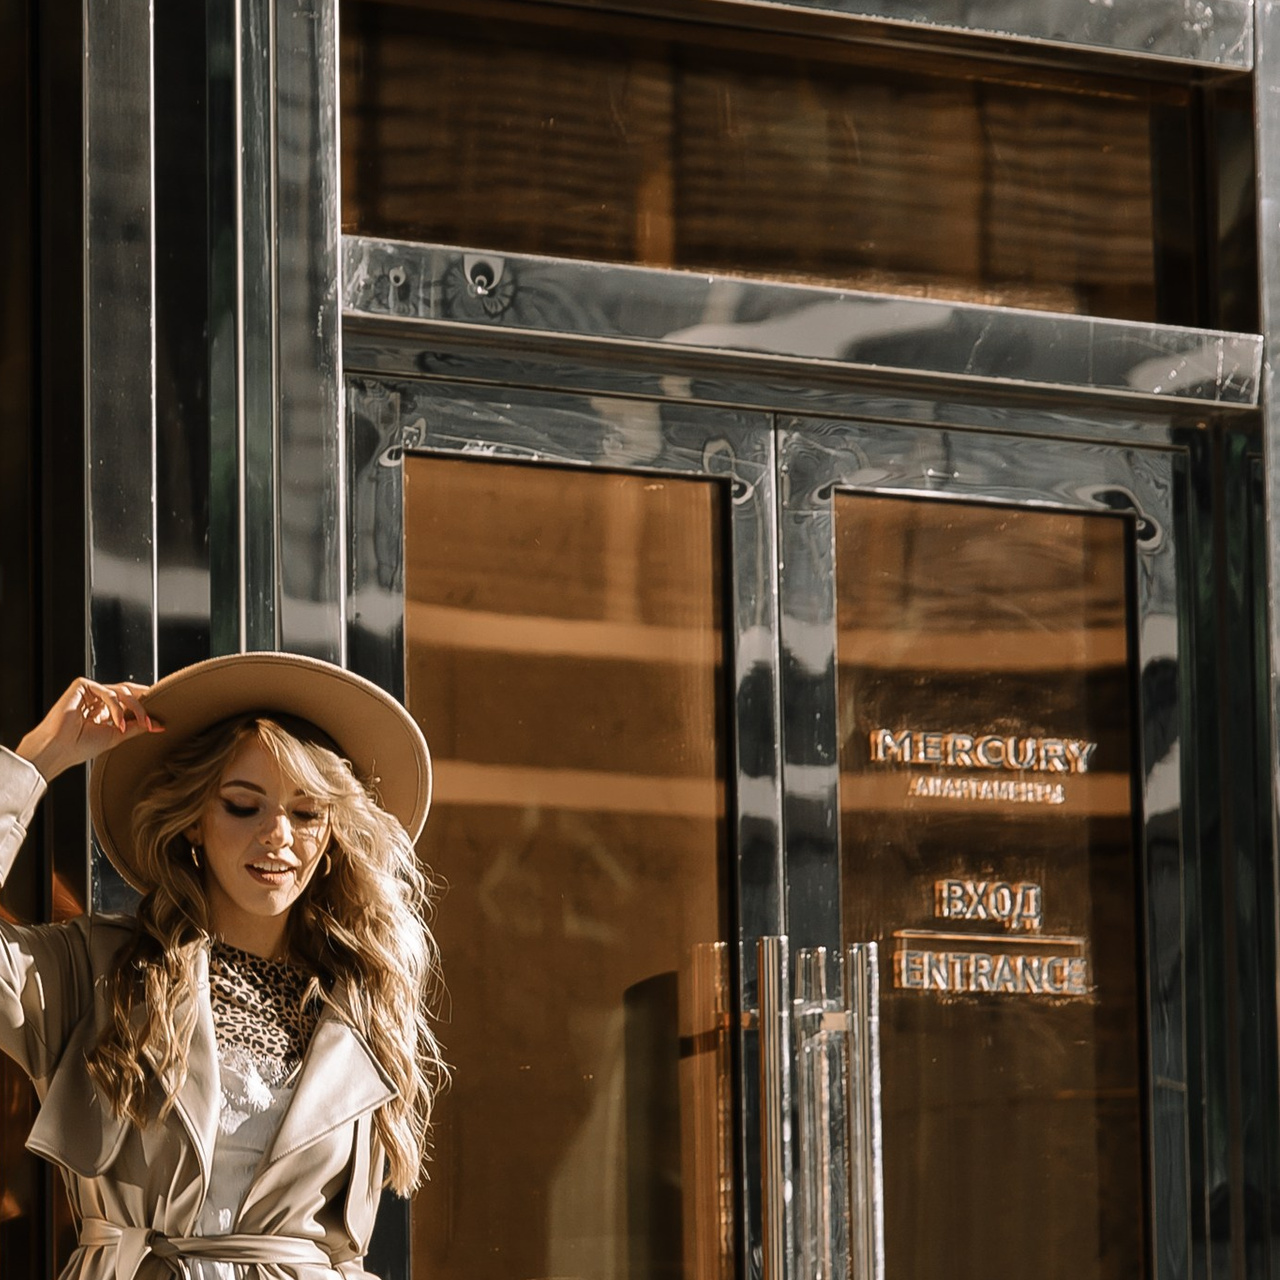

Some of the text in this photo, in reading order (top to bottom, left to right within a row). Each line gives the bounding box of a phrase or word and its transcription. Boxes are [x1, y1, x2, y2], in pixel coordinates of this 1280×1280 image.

[871, 729, 1097, 773] MERCURY
[936, 879, 1041, 929] ВХОД
[894, 949, 1088, 994] ENTRANCE
